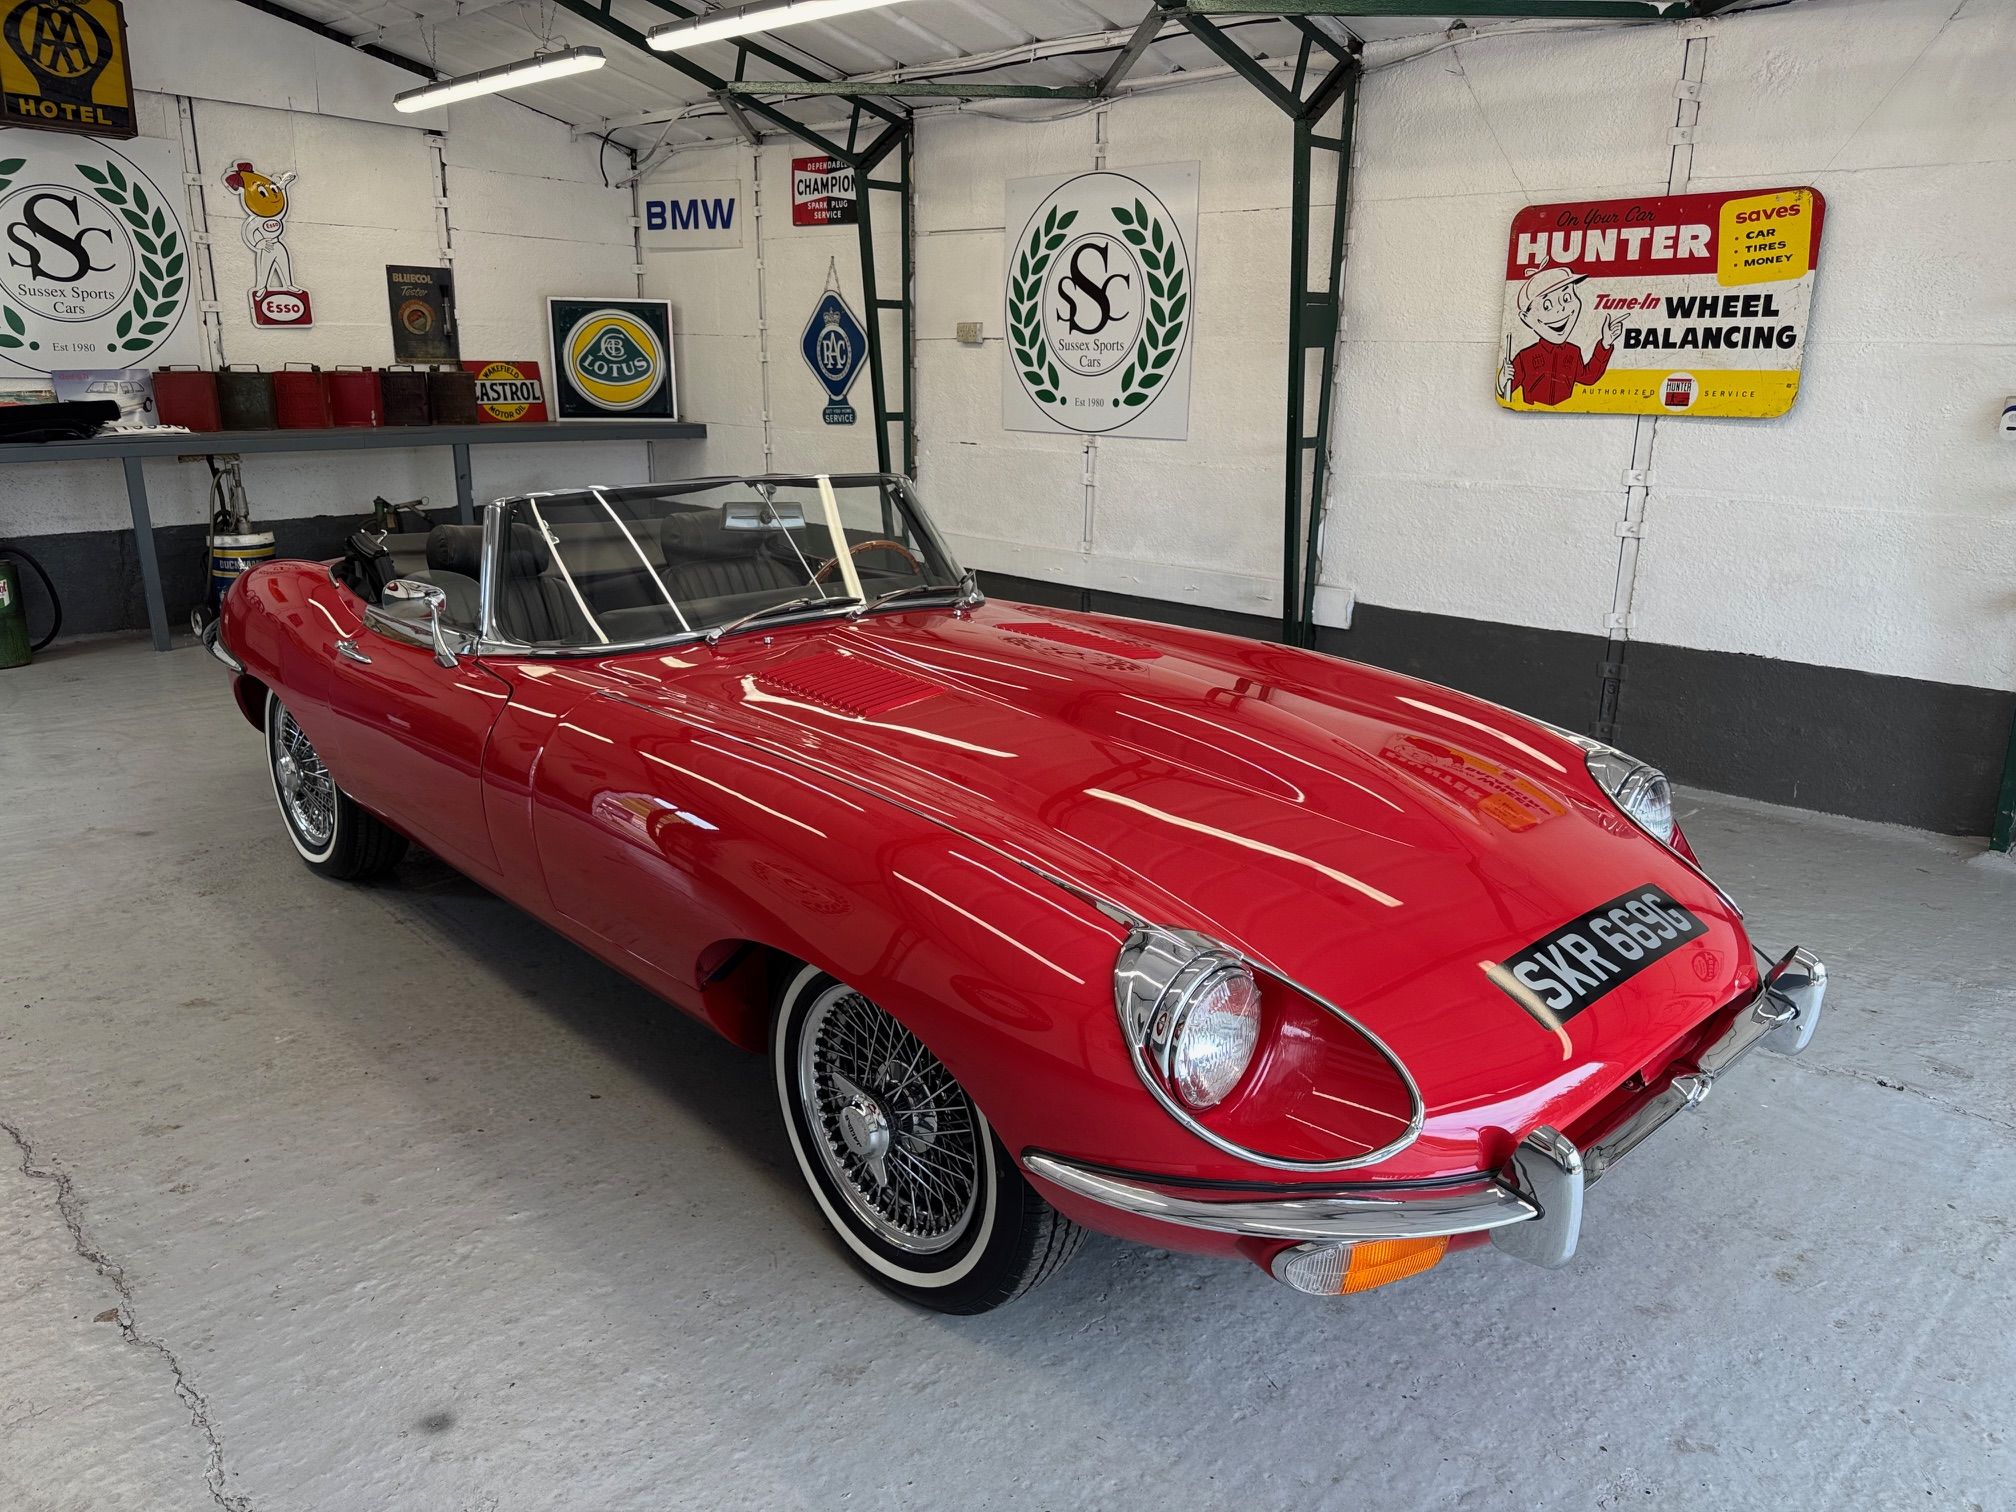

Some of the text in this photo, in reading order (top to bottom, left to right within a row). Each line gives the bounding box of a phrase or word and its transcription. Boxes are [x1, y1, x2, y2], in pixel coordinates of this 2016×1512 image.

[18, 98, 113, 125] HOTEL
[807, 200, 848, 210] SPARK PLUG
[646, 198, 735, 230] BMW
[814, 210, 842, 219] SERVICE
[1556, 206, 1656, 228] On Your Car
[1735, 204, 1801, 224] saves
[1745, 228, 1776, 240] CAR
[1516, 224, 1712, 265] HUNTER
[1745, 240, 1787, 253] TIRES
[1743, 253, 1793, 267] MONEY
[392, 272, 433, 284] BLUECOL
[18, 284, 115, 302] Sussex Sports
[400, 285, 428, 297] Tester
[53, 301, 86, 314] Cars
[1593, 292, 1779, 319] Tune-In WHEEL
[1623, 325, 1797, 349] BALANCING
[52, 342, 96, 352] Est 1980
[822, 331, 847, 369] RAC
[1058, 338, 1124, 354] Sussex Sports
[582, 355, 648, 377] LOTUS
[1079, 355, 1101, 368] Cars
[482, 365, 520, 379] WAKEFIELD
[475, 381, 541, 402] ASTROL
[1582, 387, 1756, 398] AUTHORIZED SERVICE
[1666, 381, 1692, 392] HUNTER
[1074, 397, 1105, 408] Est 1980
[489, 405, 526, 419] MOTOR OIL
[825, 414, 854, 423] SERVICE
[1512, 892, 1692, 1010] SKR 669G
